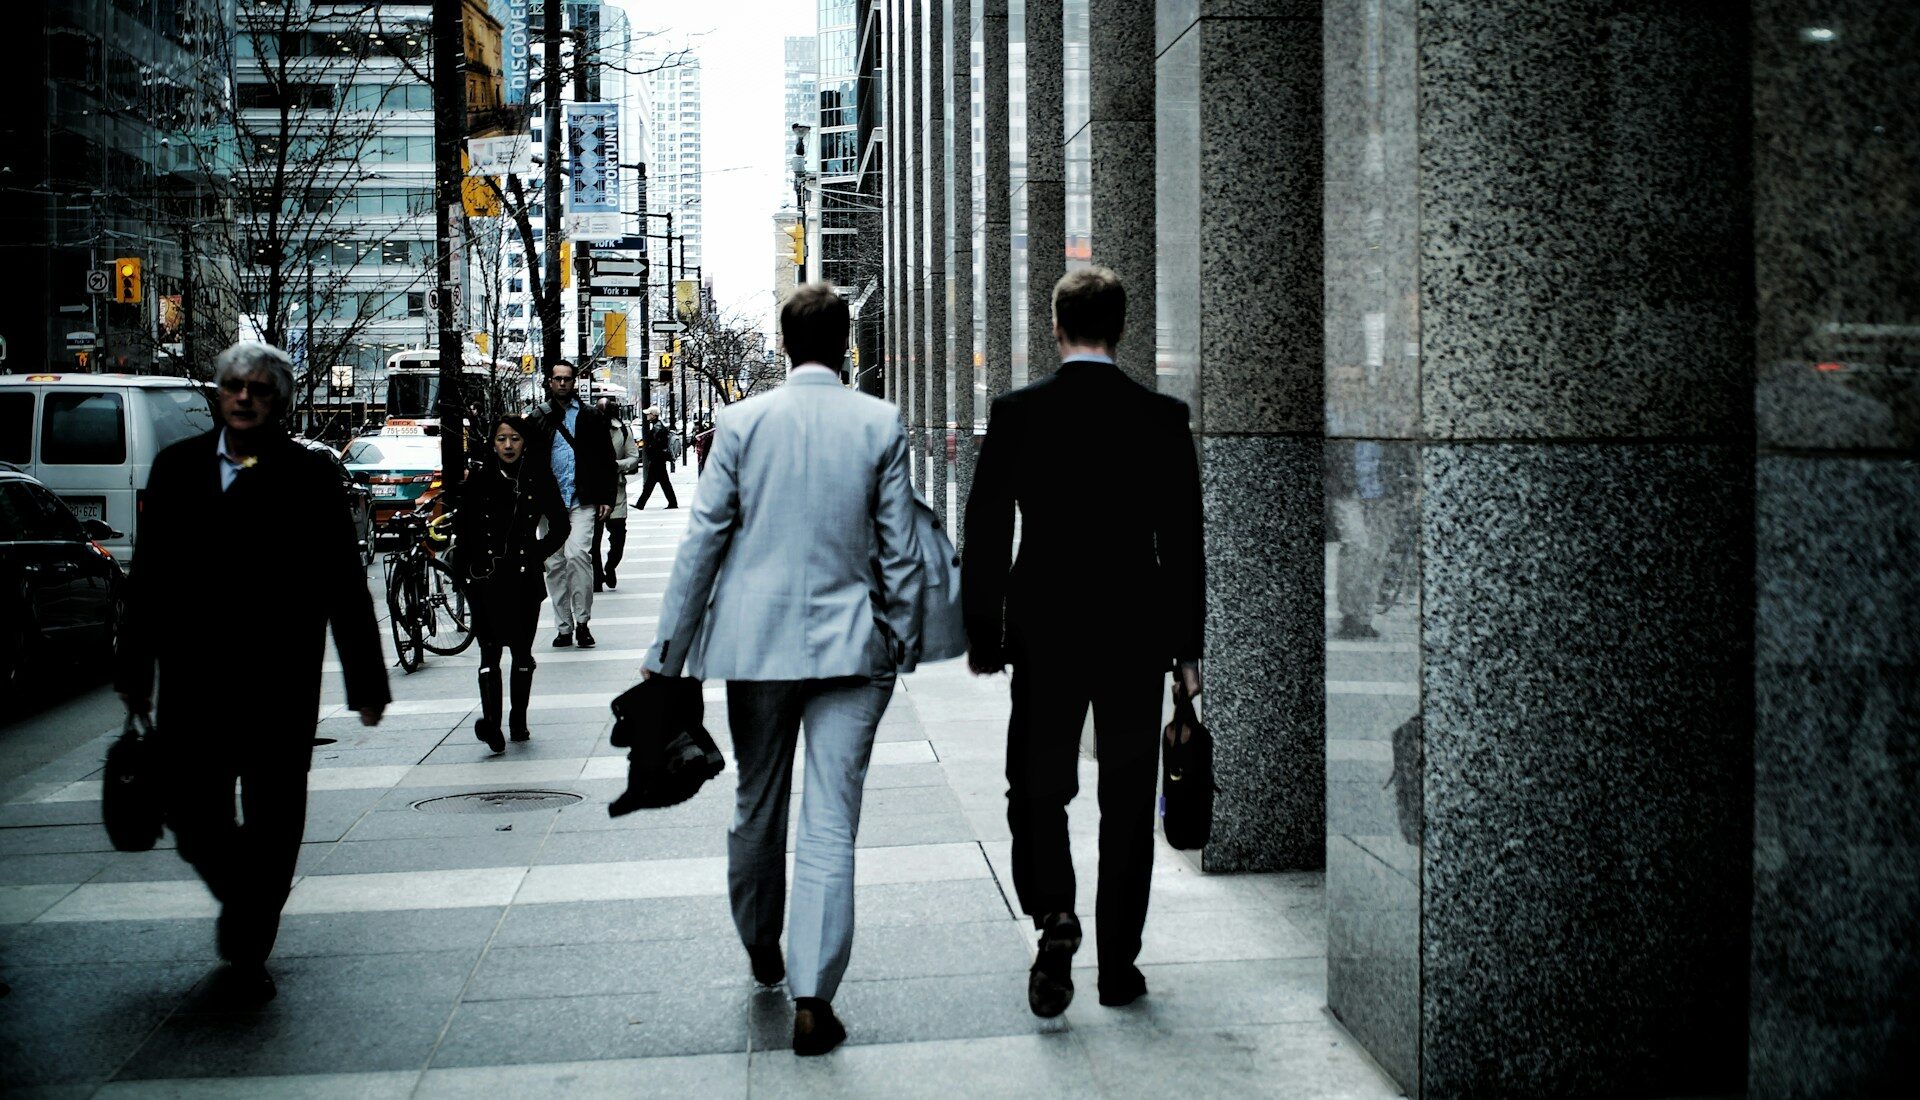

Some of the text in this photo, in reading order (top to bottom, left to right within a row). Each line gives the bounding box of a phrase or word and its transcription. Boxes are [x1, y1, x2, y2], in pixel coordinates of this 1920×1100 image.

[510, 0, 527, 89] DISCOVER
[604, 110, 618, 207] OPPORTUNITY
[603, 287, 620, 295] York
